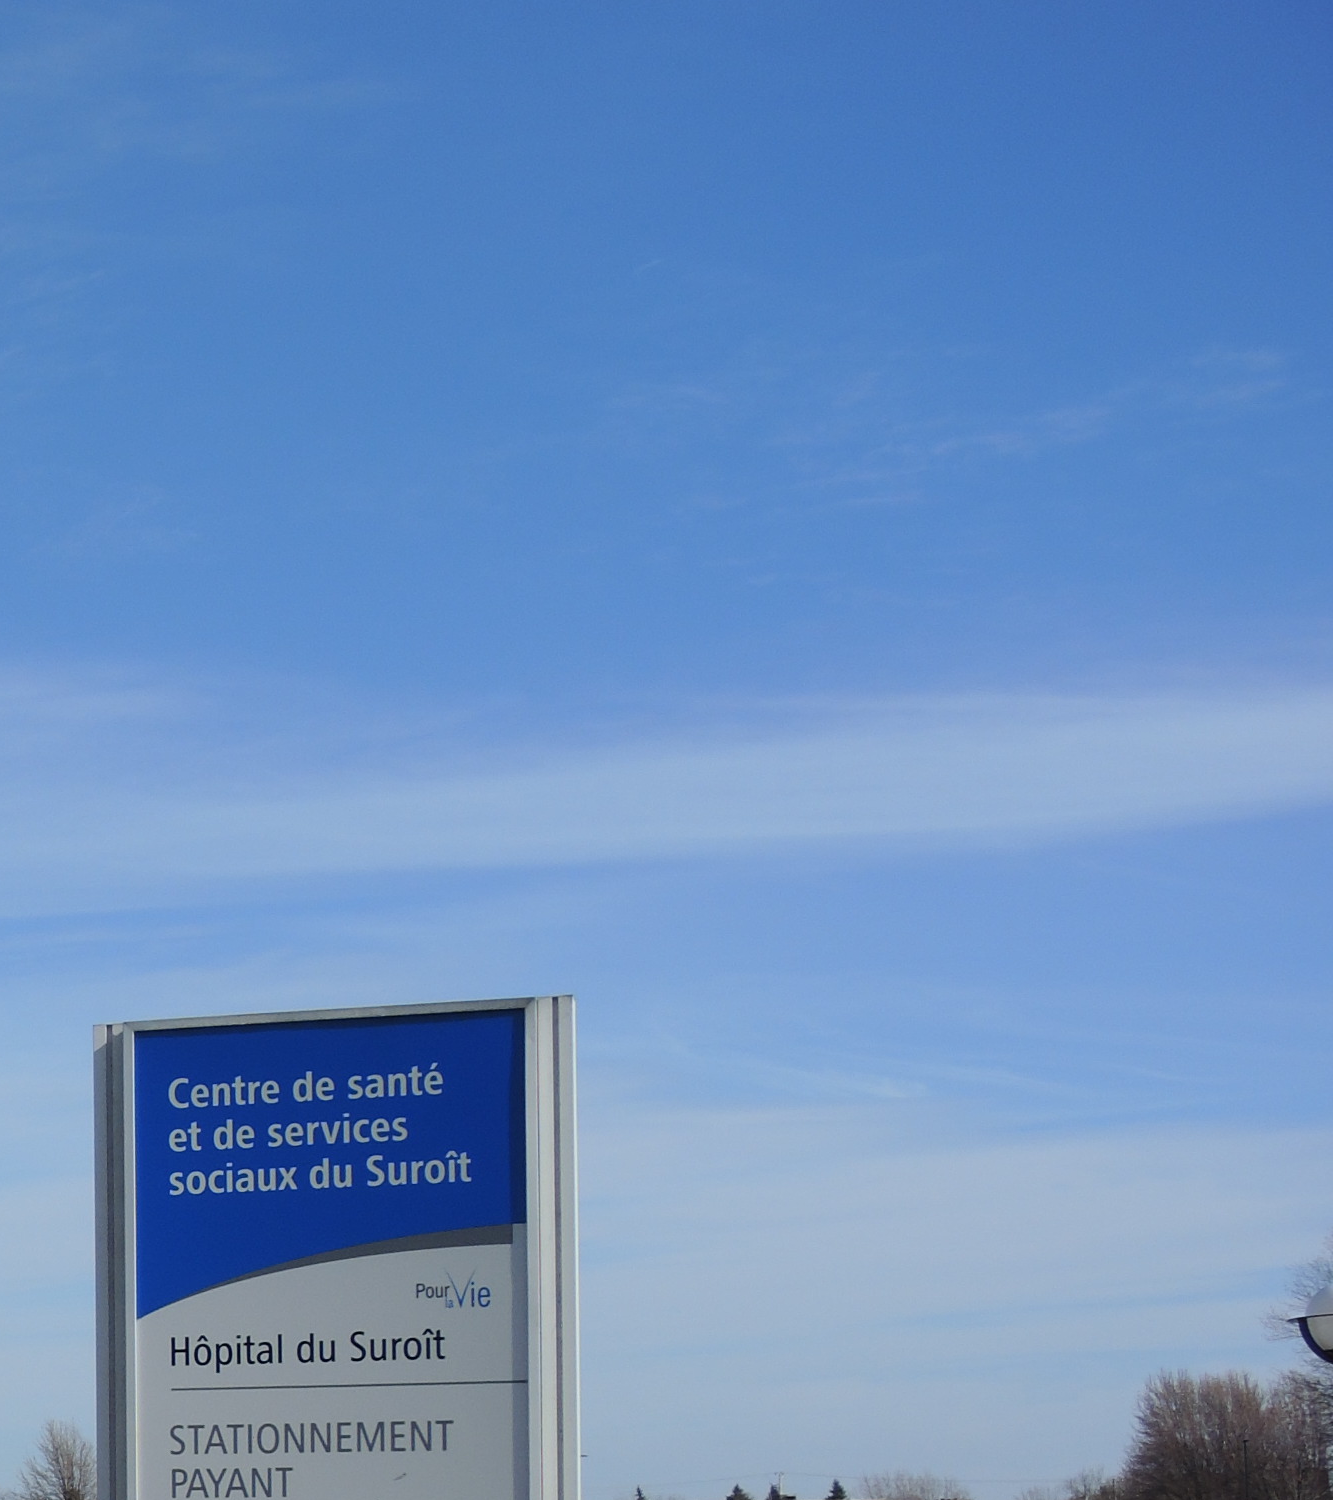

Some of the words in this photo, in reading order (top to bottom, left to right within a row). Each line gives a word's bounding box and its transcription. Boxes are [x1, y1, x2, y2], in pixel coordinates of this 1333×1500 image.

[168, 1076, 279, 1108] Centre
[293, 1071, 334, 1102] de
[348, 1063, 443, 1099] santé
[169, 1122, 201, 1152] et
[214, 1119, 254, 1150] de
[268, 1113, 407, 1147] services
[170, 1163, 297, 1195] sociaux
[310, 1158, 352, 1189] du
[366, 1151, 471, 1186] Suroît
[416, 1283, 450, 1299] Pour
[444, 1266, 491, 1308] Vie
[171, 1334, 282, 1373] Hôpital
[297, 1333, 335, 1363] du
[351, 1329, 445, 1362] Suroît
[170, 1420, 454, 1455] STATIONNEMENT
[172, 1467, 293, 1498] PAYANT
